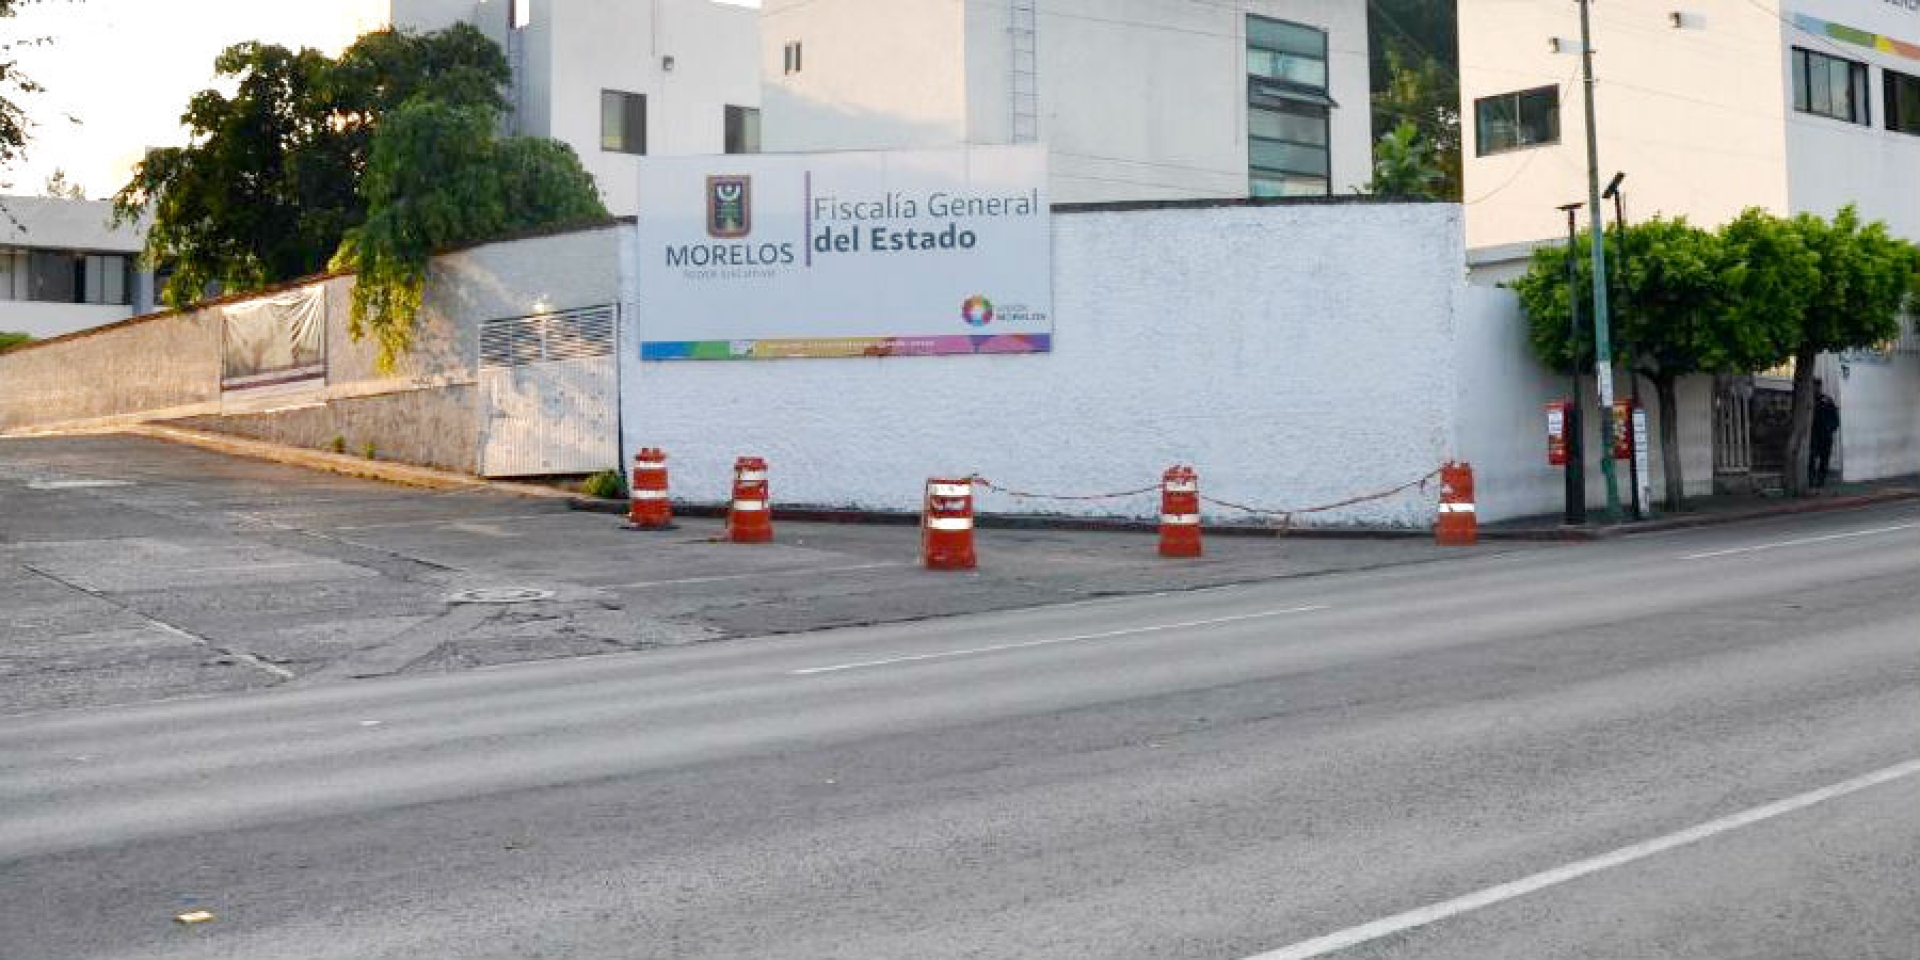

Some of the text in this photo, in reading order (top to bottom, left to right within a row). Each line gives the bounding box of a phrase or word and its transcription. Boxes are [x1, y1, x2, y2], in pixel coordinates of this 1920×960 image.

[814, 187, 1038, 220] Fiscalía General
[814, 222, 976, 252] del Estado
[665, 243, 794, 267] MORELOS
